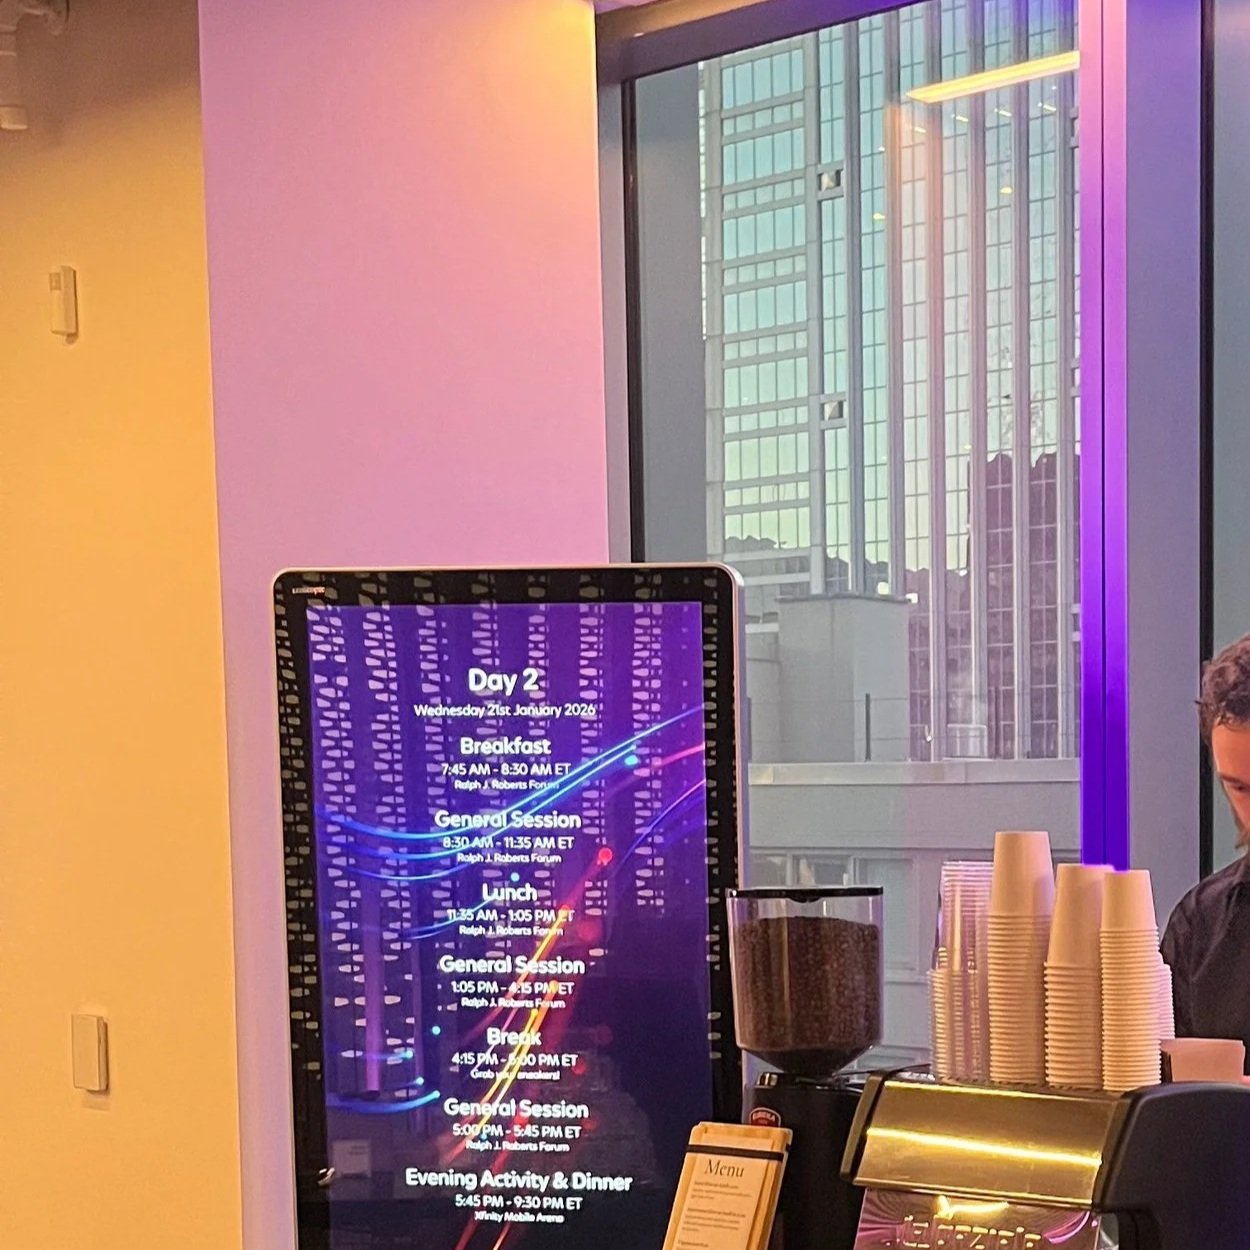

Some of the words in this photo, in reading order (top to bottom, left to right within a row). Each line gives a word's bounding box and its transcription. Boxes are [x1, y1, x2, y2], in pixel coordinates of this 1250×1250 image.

[468, 667, 518, 696] Day
[522, 667, 539, 691] 2
[413, 704, 485, 718] Wednesday
[487, 704, 511, 717] 21st
[512, 704, 562, 718] January
[564, 704, 596, 717] 2026
[460, 736, 552, 755] Breakfast
[441, 763, 467, 776] 7:45
[468, 763, 491, 776] AM
[501, 762, 529, 776] 8:30
[530, 762, 553, 776] AM
[555, 762, 572, 776] ET
[454, 779, 481, 791] Ralph
[492, 779, 528, 790] Roberts
[434, 810, 507, 828] General
[510, 810, 582, 829] Session
[442, 836, 469, 849] 8:30
[470, 836, 493, 849] AM
[504, 836, 532, 849] 11:35
[533, 836, 555, 849] AM
[557, 836, 575, 849] ET
[457, 852, 484, 864] Ralph
[494, 853, 530, 863] Roberts
[531, 853, 562, 863] Forum
[482, 883, 538, 901] Lunch
[446, 909, 474, 921] 11:35
[475, 909, 498, 921] AM
[508, 909, 533, 922] 1:05
[534, 909, 556, 922] PM
[459, 925, 486, 937] Ralph
[495, 925, 532, 936] Roberts
[439, 955, 512, 973] General
[515, 955, 585, 974] Session
[451, 981, 476, 993] 1:05
[477, 981, 499, 993] PM
[534, 981, 557, 994] PM
[558, 981, 575, 994] ET
[461, 998, 488, 1009] Ralph
[498, 998, 534, 1008] Roberts
[487, 1027, 542, 1046] Break
[451, 1053, 476, 1065] 4:15
[477, 1053, 499, 1065] PM
[538, 1053, 560, 1066] PM
[561, 1054, 578, 1067] ET
[470, 1069, 495, 1080] Grab
[443, 1098, 516, 1117] General
[519, 1099, 589, 1119] Session
[452, 1123, 481, 1136] 5:00
[482, 1124, 504, 1137] PM
[513, 1124, 540, 1137] 5:45
[541, 1125, 563, 1138] PM
[565, 1126, 582, 1138] ET
[465, 1140, 493, 1151] Ralph
[502, 1140, 538, 1151] Roberts
[539, 1141, 570, 1152] Forum
[704, 1158, 745, 1178] Menu
[405, 1167, 477, 1190] Evening
[480, 1169, 549, 1192] Activity
[552, 1172, 569, 1189] &
[572, 1172, 633, 1192] Dinner
[455, 1194, 481, 1207] 5:45
[482, 1195, 504, 1208] PM
[513, 1195, 541, 1208] 9:30
[542, 1196, 564, 1209] PM
[566, 1197, 583, 1210] ET
[503, 1211, 535, 1222] Mobile
[536, 1212, 565, 1223] Arena
